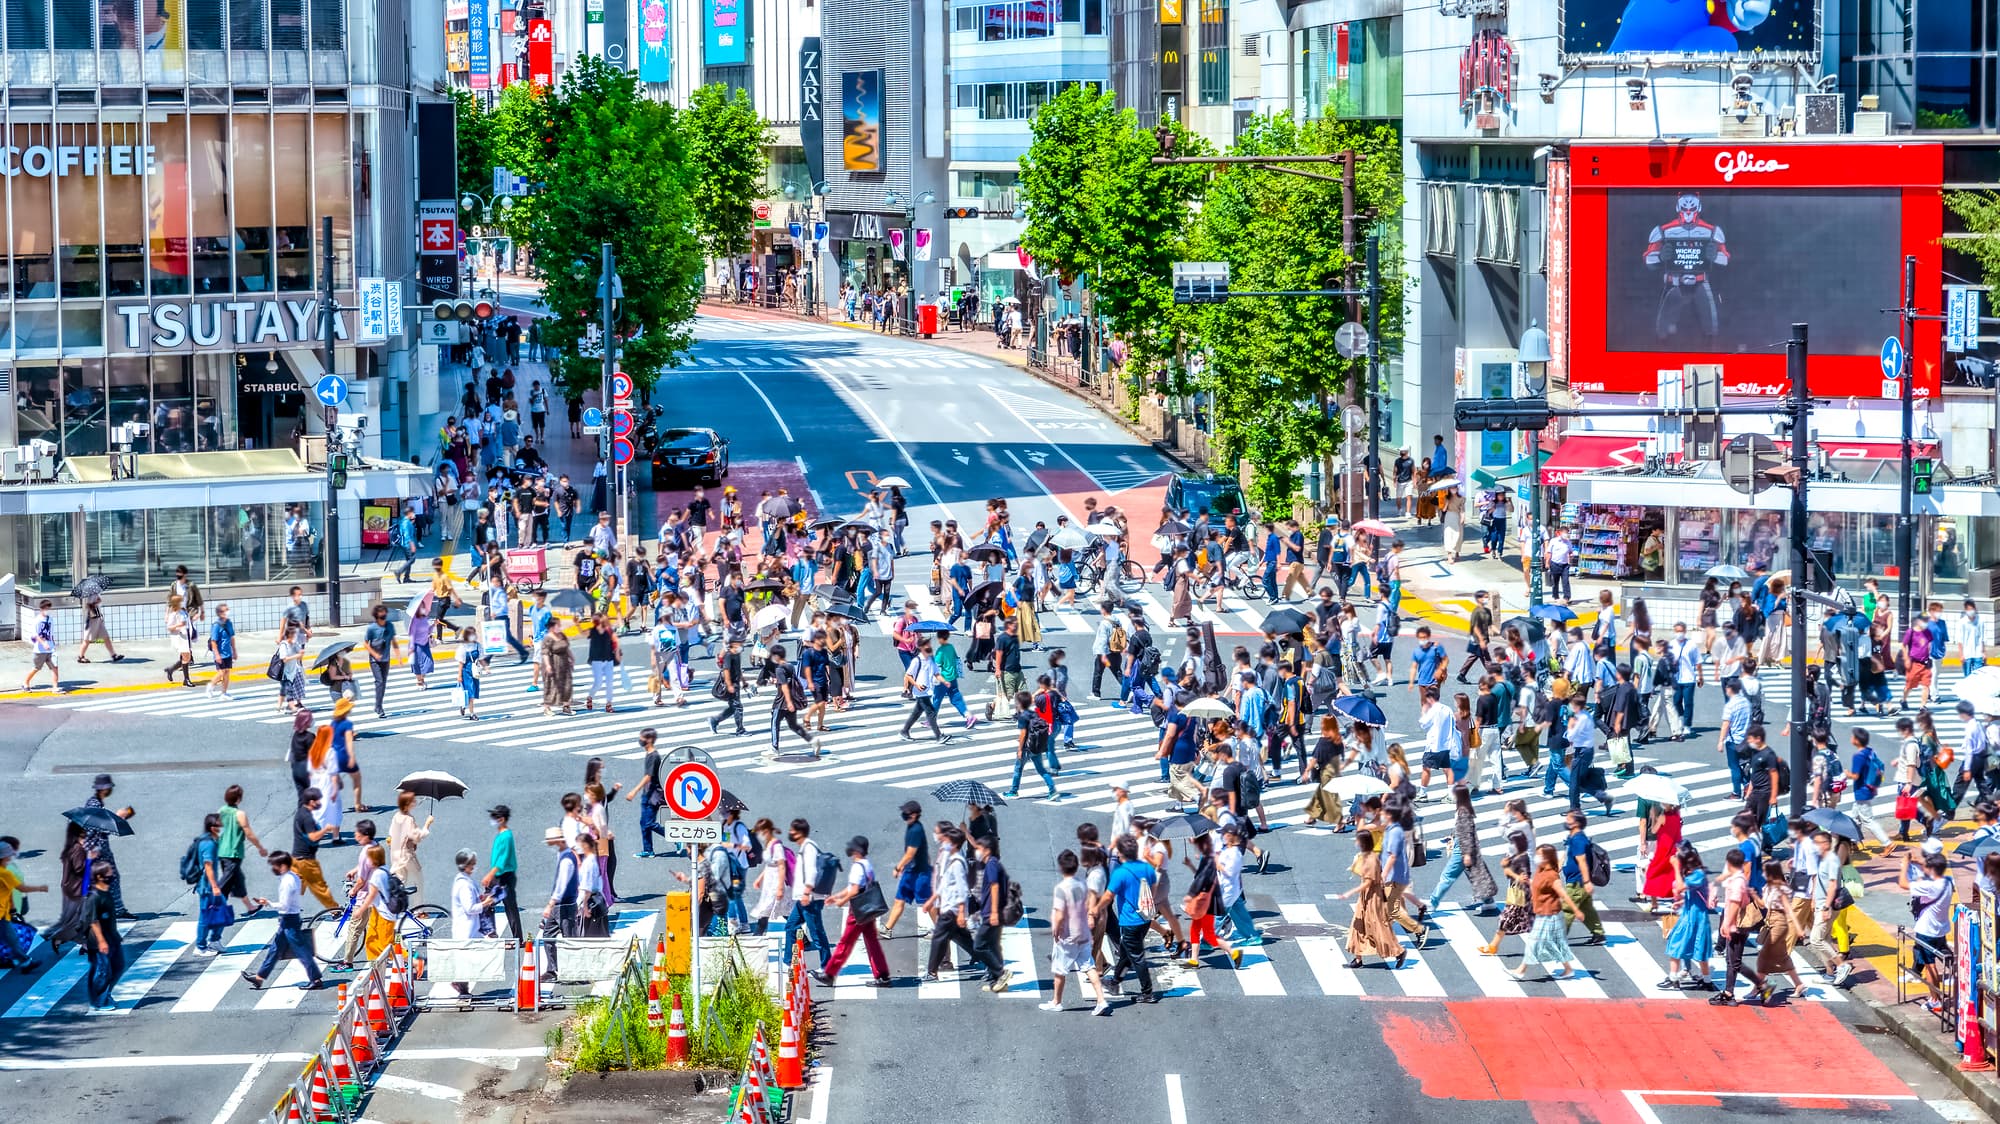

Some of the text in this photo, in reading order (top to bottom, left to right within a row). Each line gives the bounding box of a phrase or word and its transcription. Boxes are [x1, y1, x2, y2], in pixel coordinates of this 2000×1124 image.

[471, 3, 483, 53] 渋谷整形
[803, 51, 820, 121] ZARA
[0, 145, 156, 178] COFFEE
[427, 223, 450, 248] 本
[852, 213, 884, 239] ZARA
[426, 276, 453, 284] WIRED
[117, 299, 349, 348] TSUTAYA
[371, 283, 383, 335] 渋谷駅前
[389, 284, 399, 333] スクランブル式
[1955, 291, 1964, 346] 渋谷駅前
[669, 826, 717, 839] ここから
